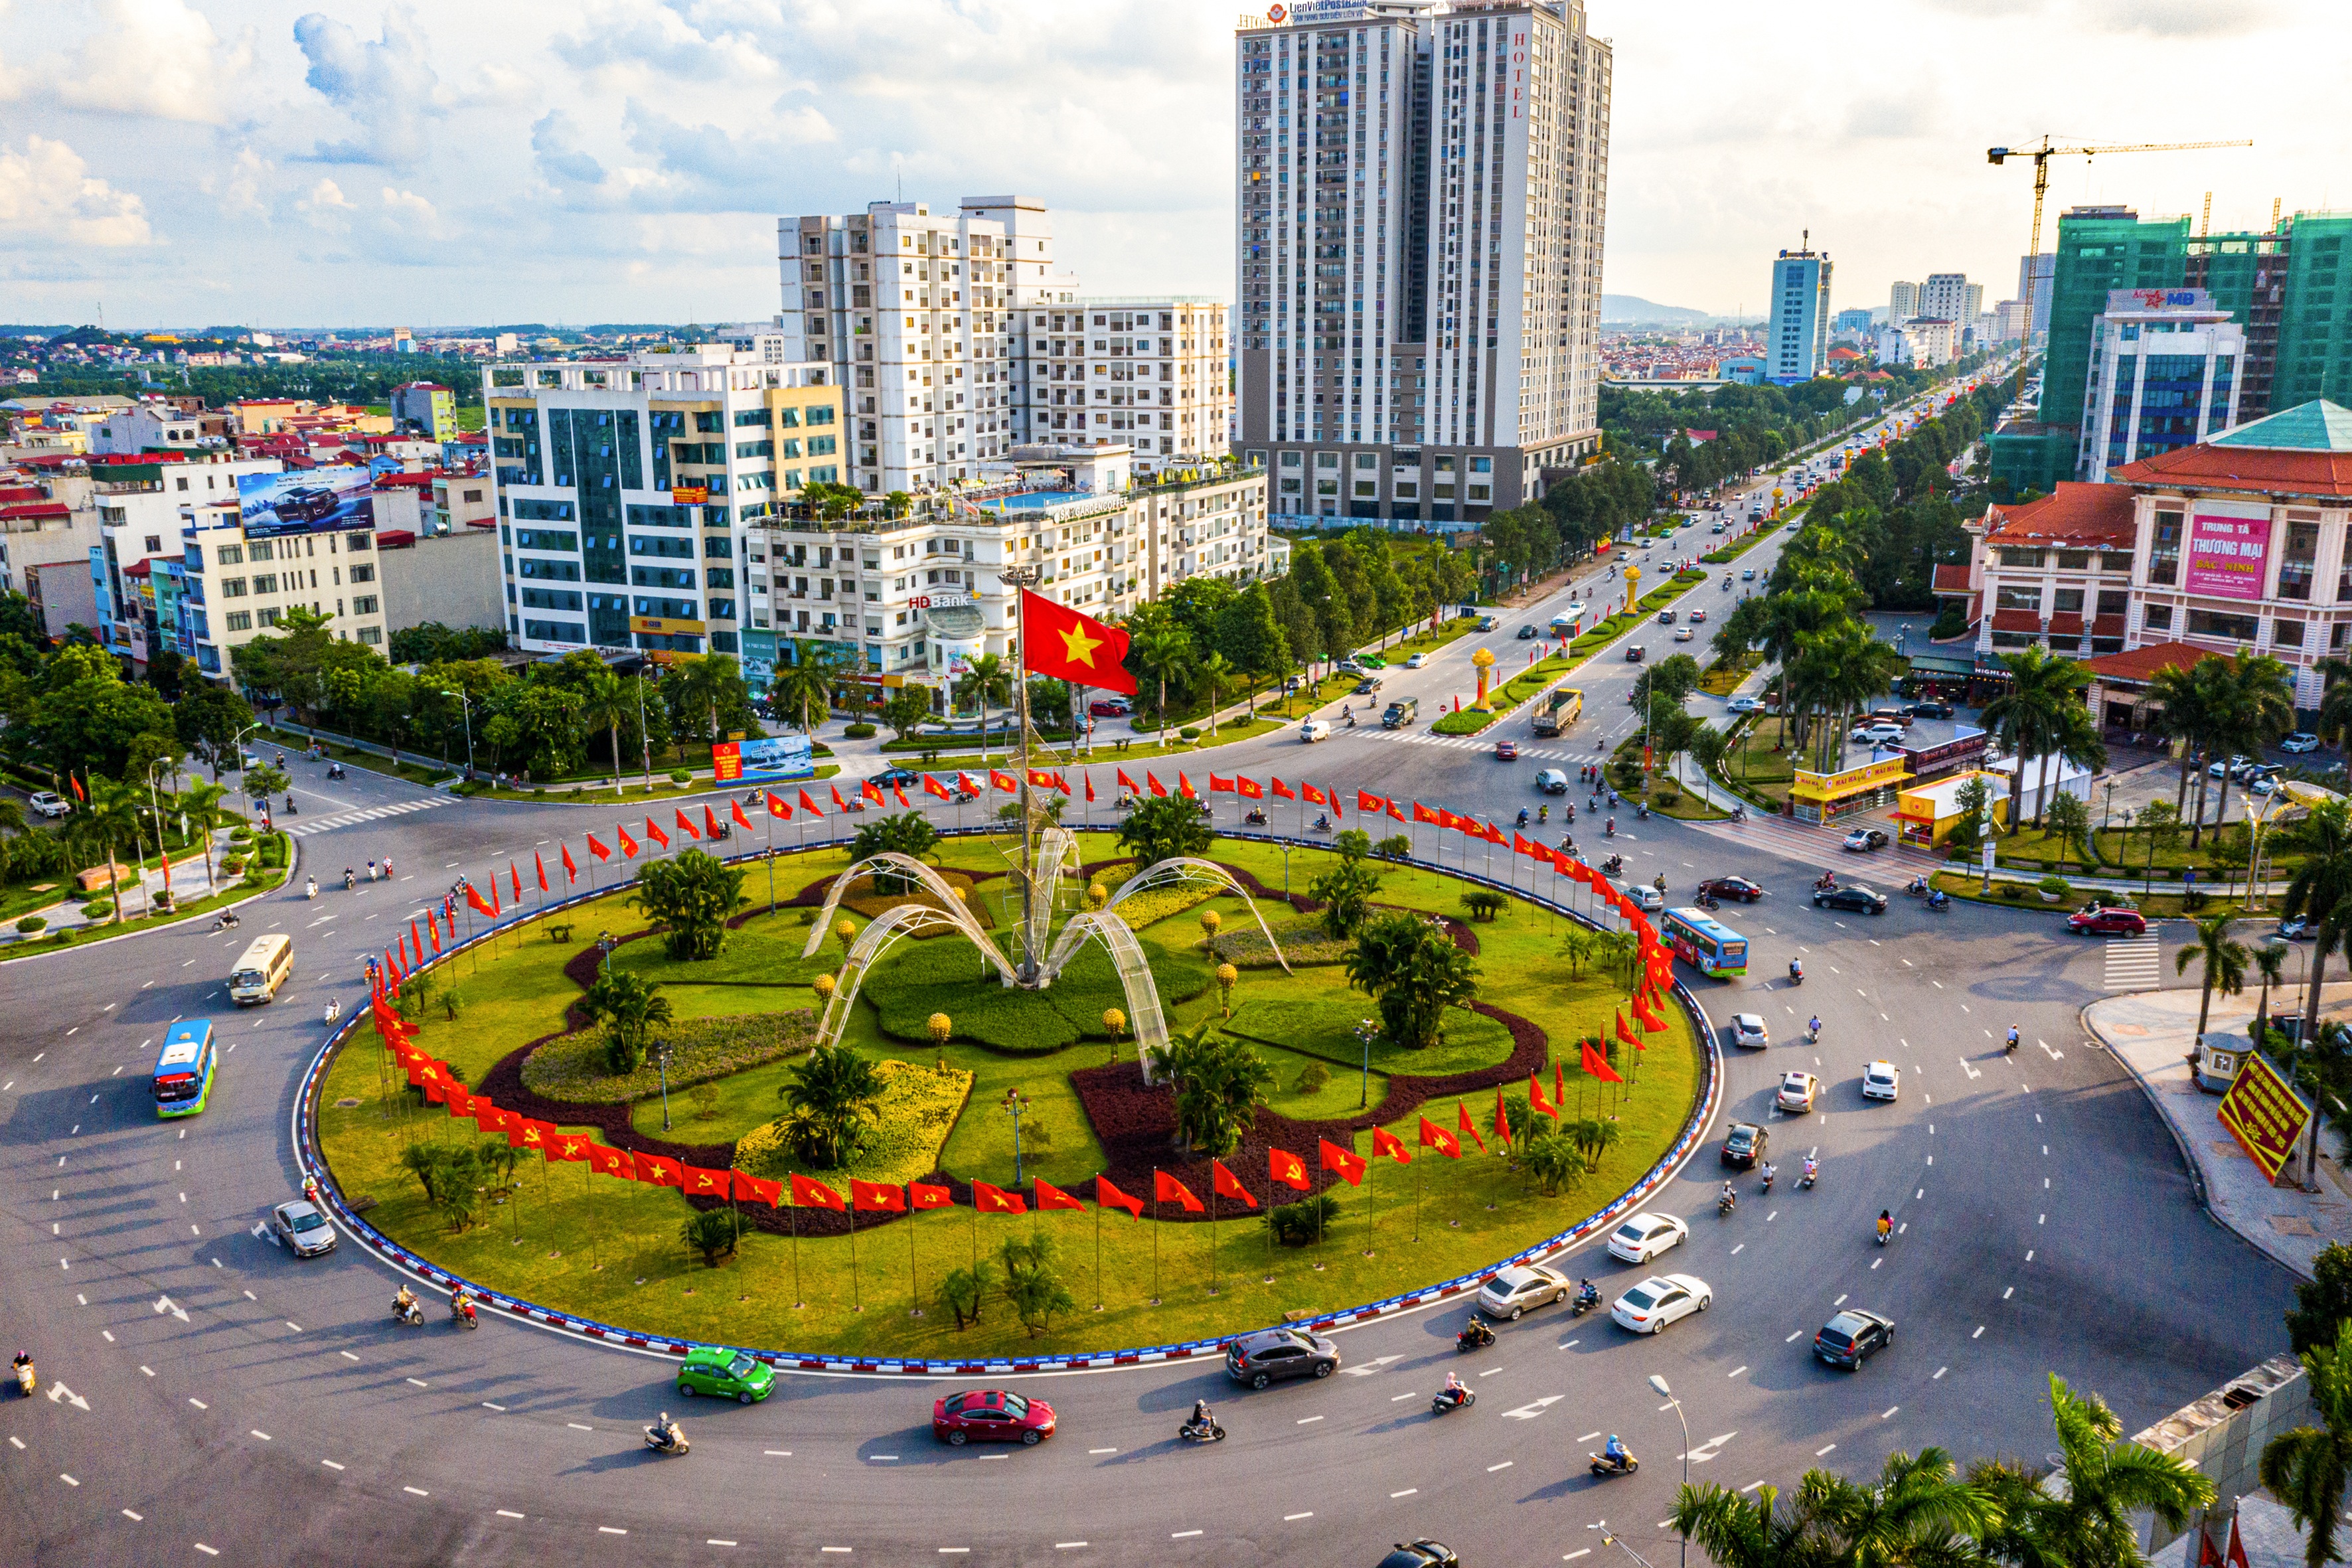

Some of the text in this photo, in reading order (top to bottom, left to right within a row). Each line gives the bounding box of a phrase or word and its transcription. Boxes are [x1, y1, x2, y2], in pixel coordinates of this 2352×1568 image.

[1513, 33, 1525, 118] HOTEL
[2166, 292, 2195, 305] MB
[2202, 522, 2233, 533] TRUNG
[2193, 538, 2263, 560] THƯƠNG MẠI
[2225, 562, 2254, 573] NINH
[909, 595, 969, 609] HDBank
[1975, 668, 2013, 677] HIGHLAN
